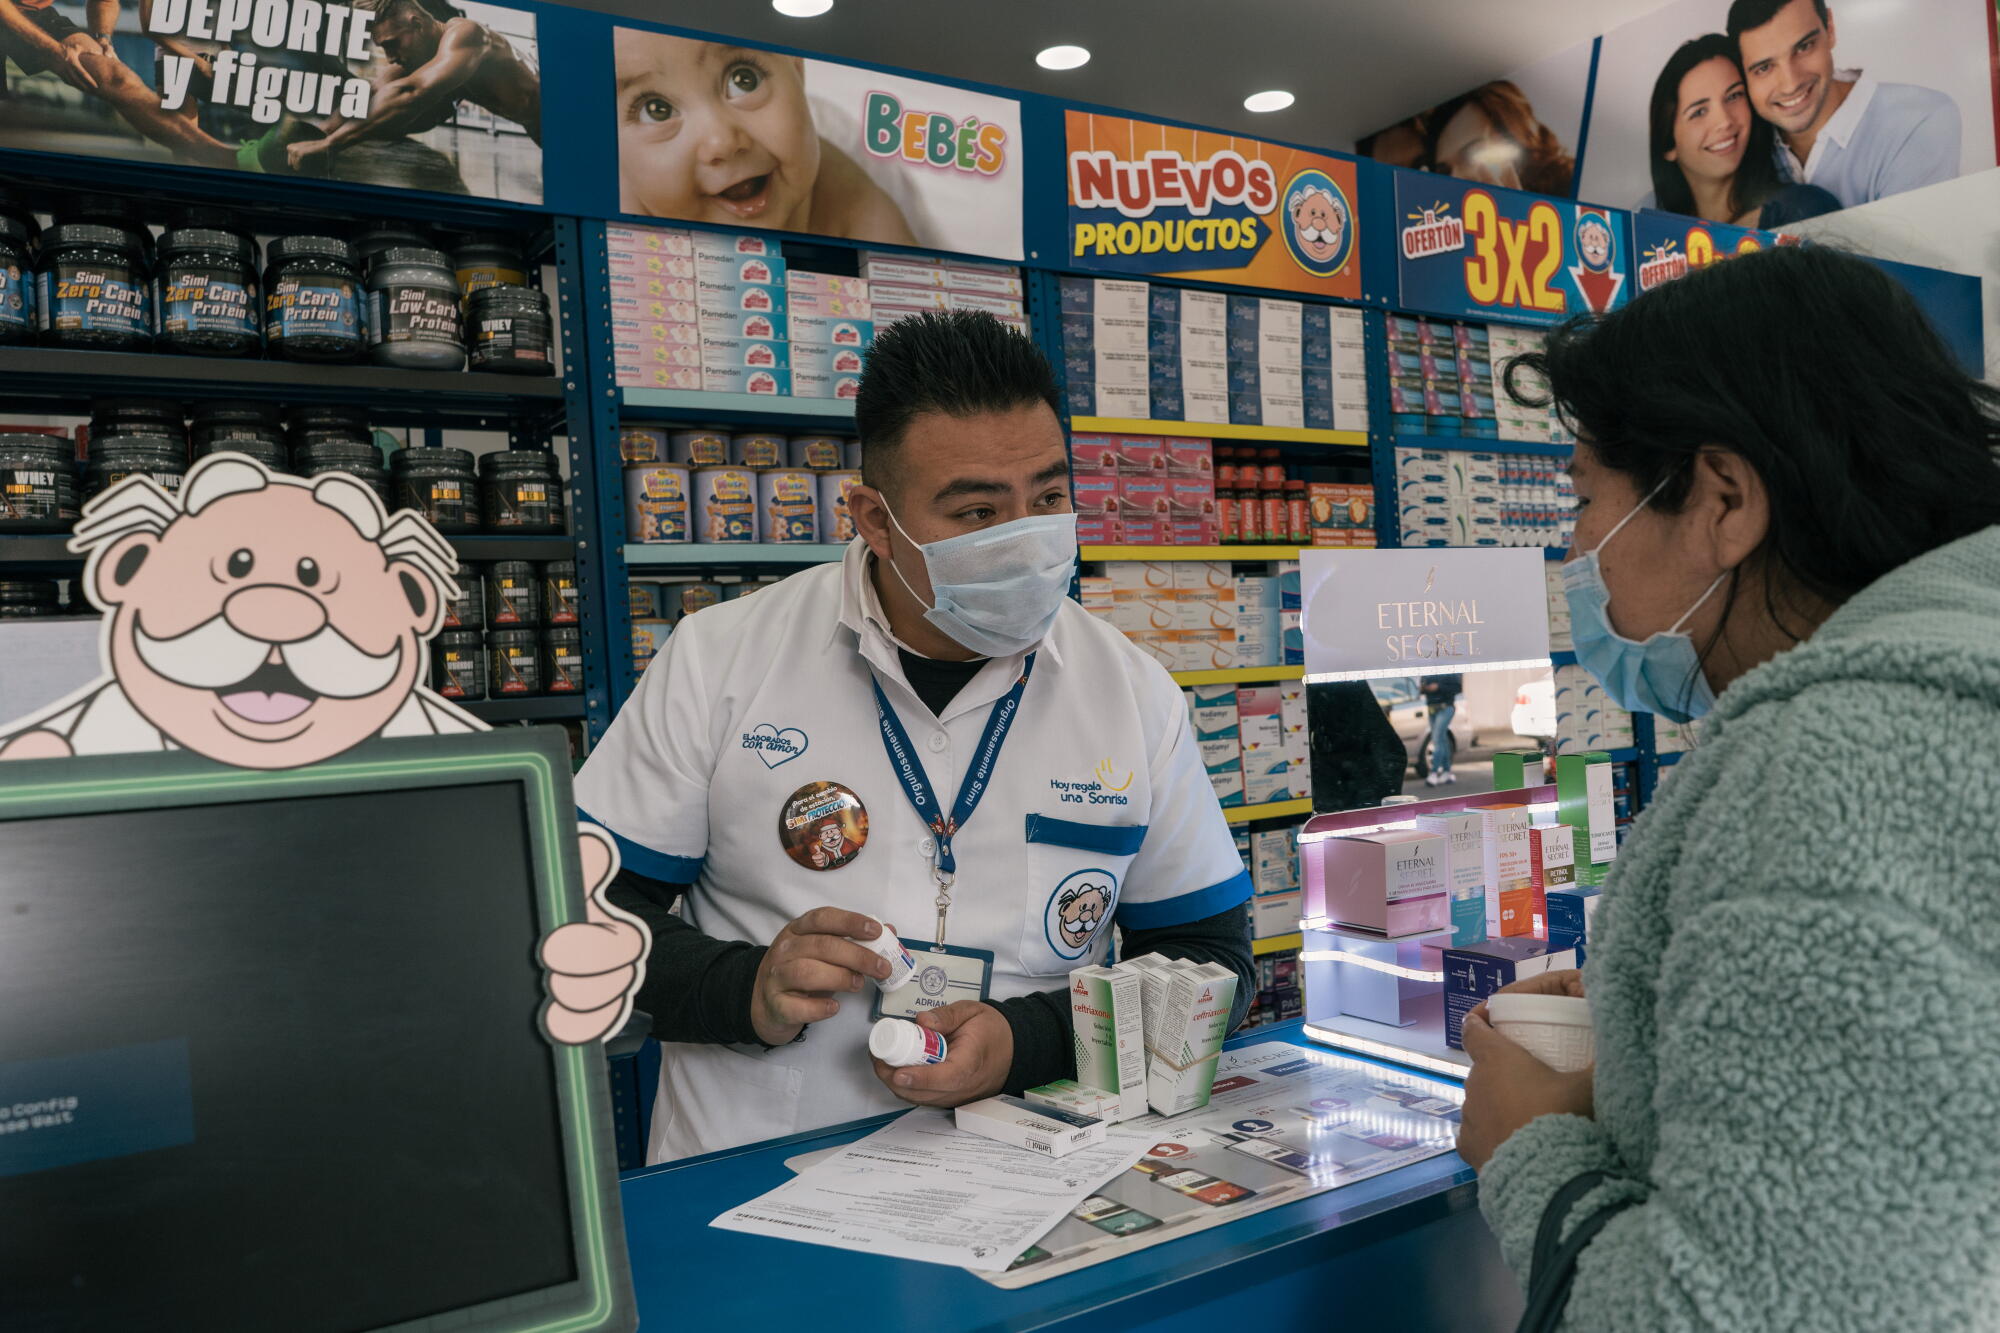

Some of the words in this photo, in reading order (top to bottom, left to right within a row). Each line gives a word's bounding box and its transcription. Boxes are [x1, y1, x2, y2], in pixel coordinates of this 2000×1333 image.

[149, 0, 377, 61] DEPORTE
[161, 54, 195, 111] y
[211, 51, 371, 123] figura
[866, 92, 1006, 174] BEBÉS
[1076, 156, 1274, 210] NUEVOS
[1074, 216, 1258, 256] PRODUCTOS
[1404, 219, 1462, 255] OFERTÓN
[74, 271, 106, 284] Simi
[181, 274, 209, 287] Simi
[56, 282, 142, 305] Zero-Carb
[165, 286, 248, 305] Zero-Carb
[276, 281, 299, 295] Simi
[400, 289, 426, 302] Simi
[267, 289, 340, 311] Zero-Carb
[389, 299, 457, 319] Low-Carb
[86, 300, 141, 320] Protein
[191, 301, 247, 320] Protein
[284, 306, 339, 322] Protein
[410, 315, 457, 333] Protein
[482, 319, 512, 332] WHEY
[14, 471, 55, 486] WHEY
[1377, 600, 1485, 629] ETERNAL
[1386, 631, 1478, 662] SECRET
[742, 733, 791, 746] ELABORADOS
[742, 740, 763, 750] con
[766, 742, 799, 755] amor
[977, 698, 1015, 779] Orgullosamente
[882, 720, 925, 806] Orgullosamente
[964, 780, 982, 807] Simi
[1050, 779, 1070, 792] Hoy
[1071, 780, 1102, 792] regala
[1061, 794, 1083, 803] una
[1088, 792, 1128, 806] Sonrisa
[1450, 830, 1482, 842] ETERNAL
[1498, 821, 1528, 833] ETERNAL
[1500, 831, 1527, 842] SECRET
[1545, 843, 1569, 854] ETERNAL
[1548, 852, 1569, 861] SECRET
[1397, 857, 1436, 871] ETERNAL
